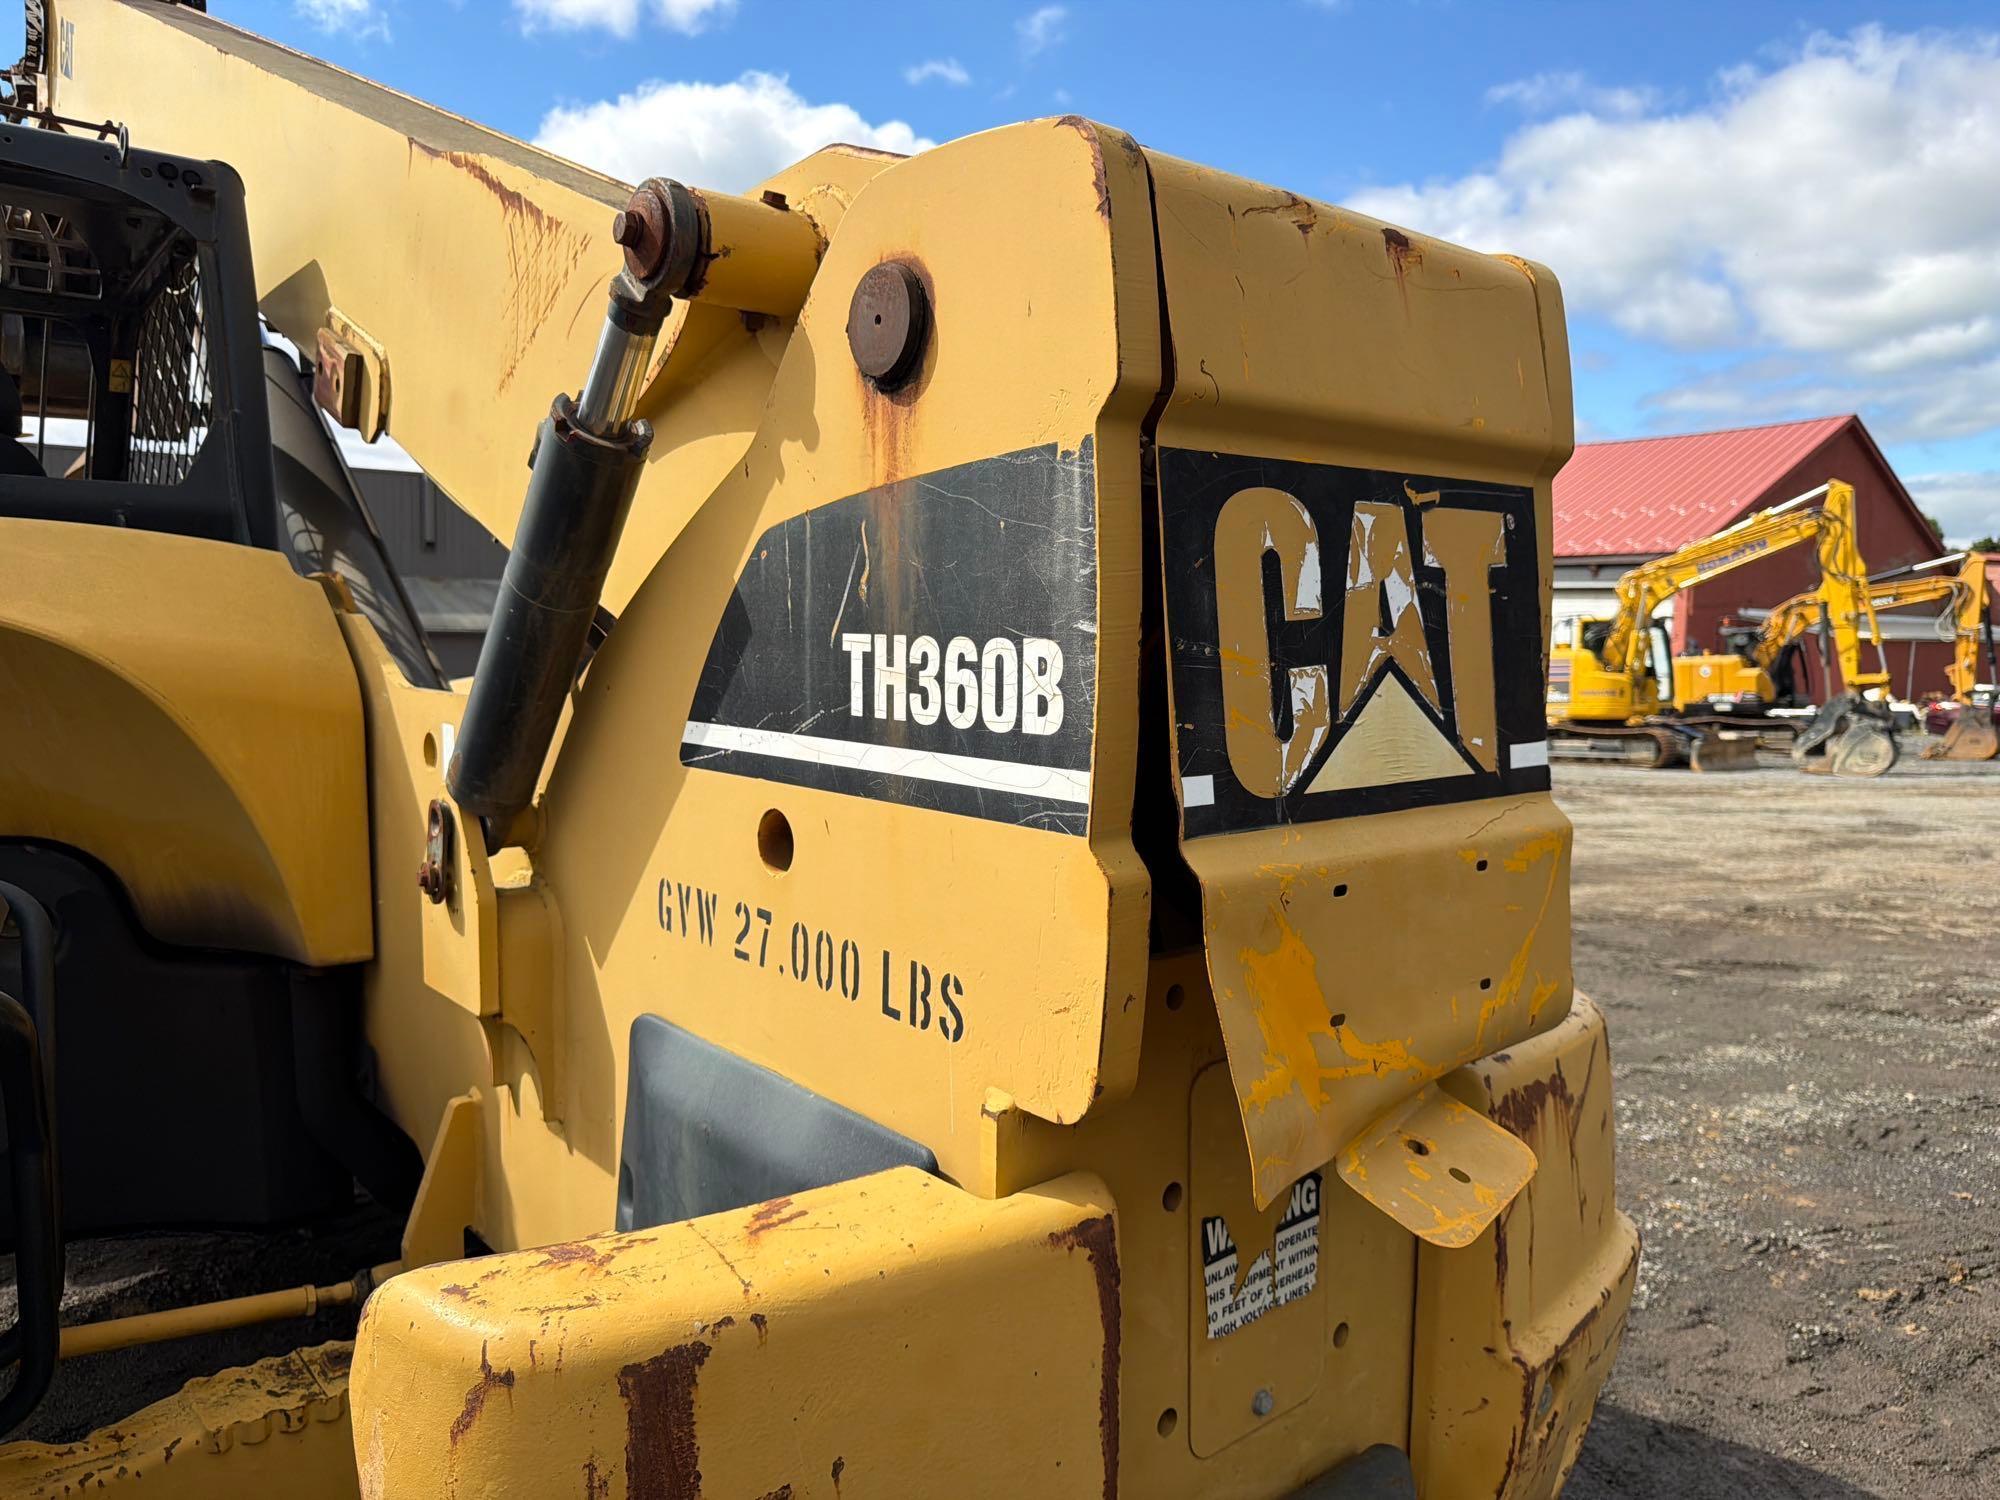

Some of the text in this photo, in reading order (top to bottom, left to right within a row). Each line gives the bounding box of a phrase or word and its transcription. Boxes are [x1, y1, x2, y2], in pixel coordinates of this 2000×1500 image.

[60, 16, 74, 80] CAT
[1214, 487, 1507, 798] CAT
[842, 633, 1064, 736] TH360B
[882, 950, 964, 1043] LBS
[1206, 1263, 1239, 1286] UNLAW
[1277, 1225, 1318, 1252] OPERATE
[1229, 1258, 1285, 1295] EUIPMENT
[1214, 1320, 1237, 1338] HIGH
[1284, 1282, 1310, 1304] LINES
[1222, 1297, 1246, 1317] FEET
[1250, 1288, 1263, 1303] OF
